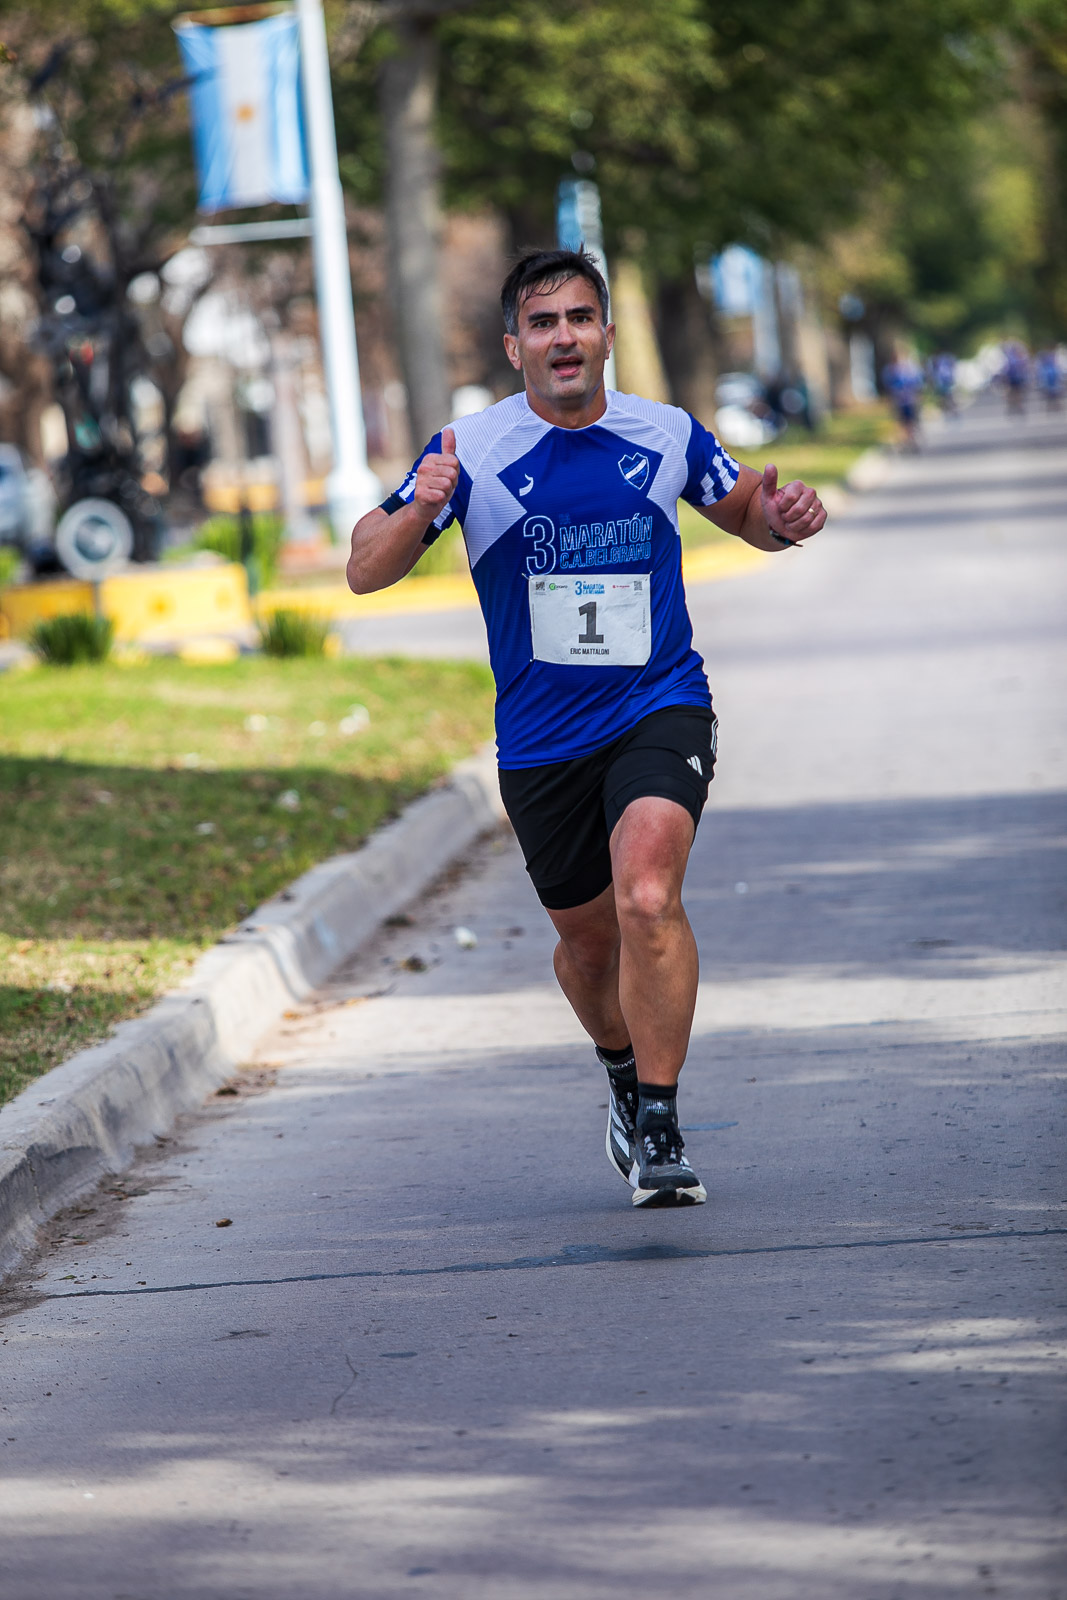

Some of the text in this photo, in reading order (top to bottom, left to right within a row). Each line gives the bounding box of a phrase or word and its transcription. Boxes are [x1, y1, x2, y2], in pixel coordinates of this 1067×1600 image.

[523, 512, 653, 576] 3 MARATÓN
[575, 580, 583, 596] 3
[578, 601, 604, 644] 1
